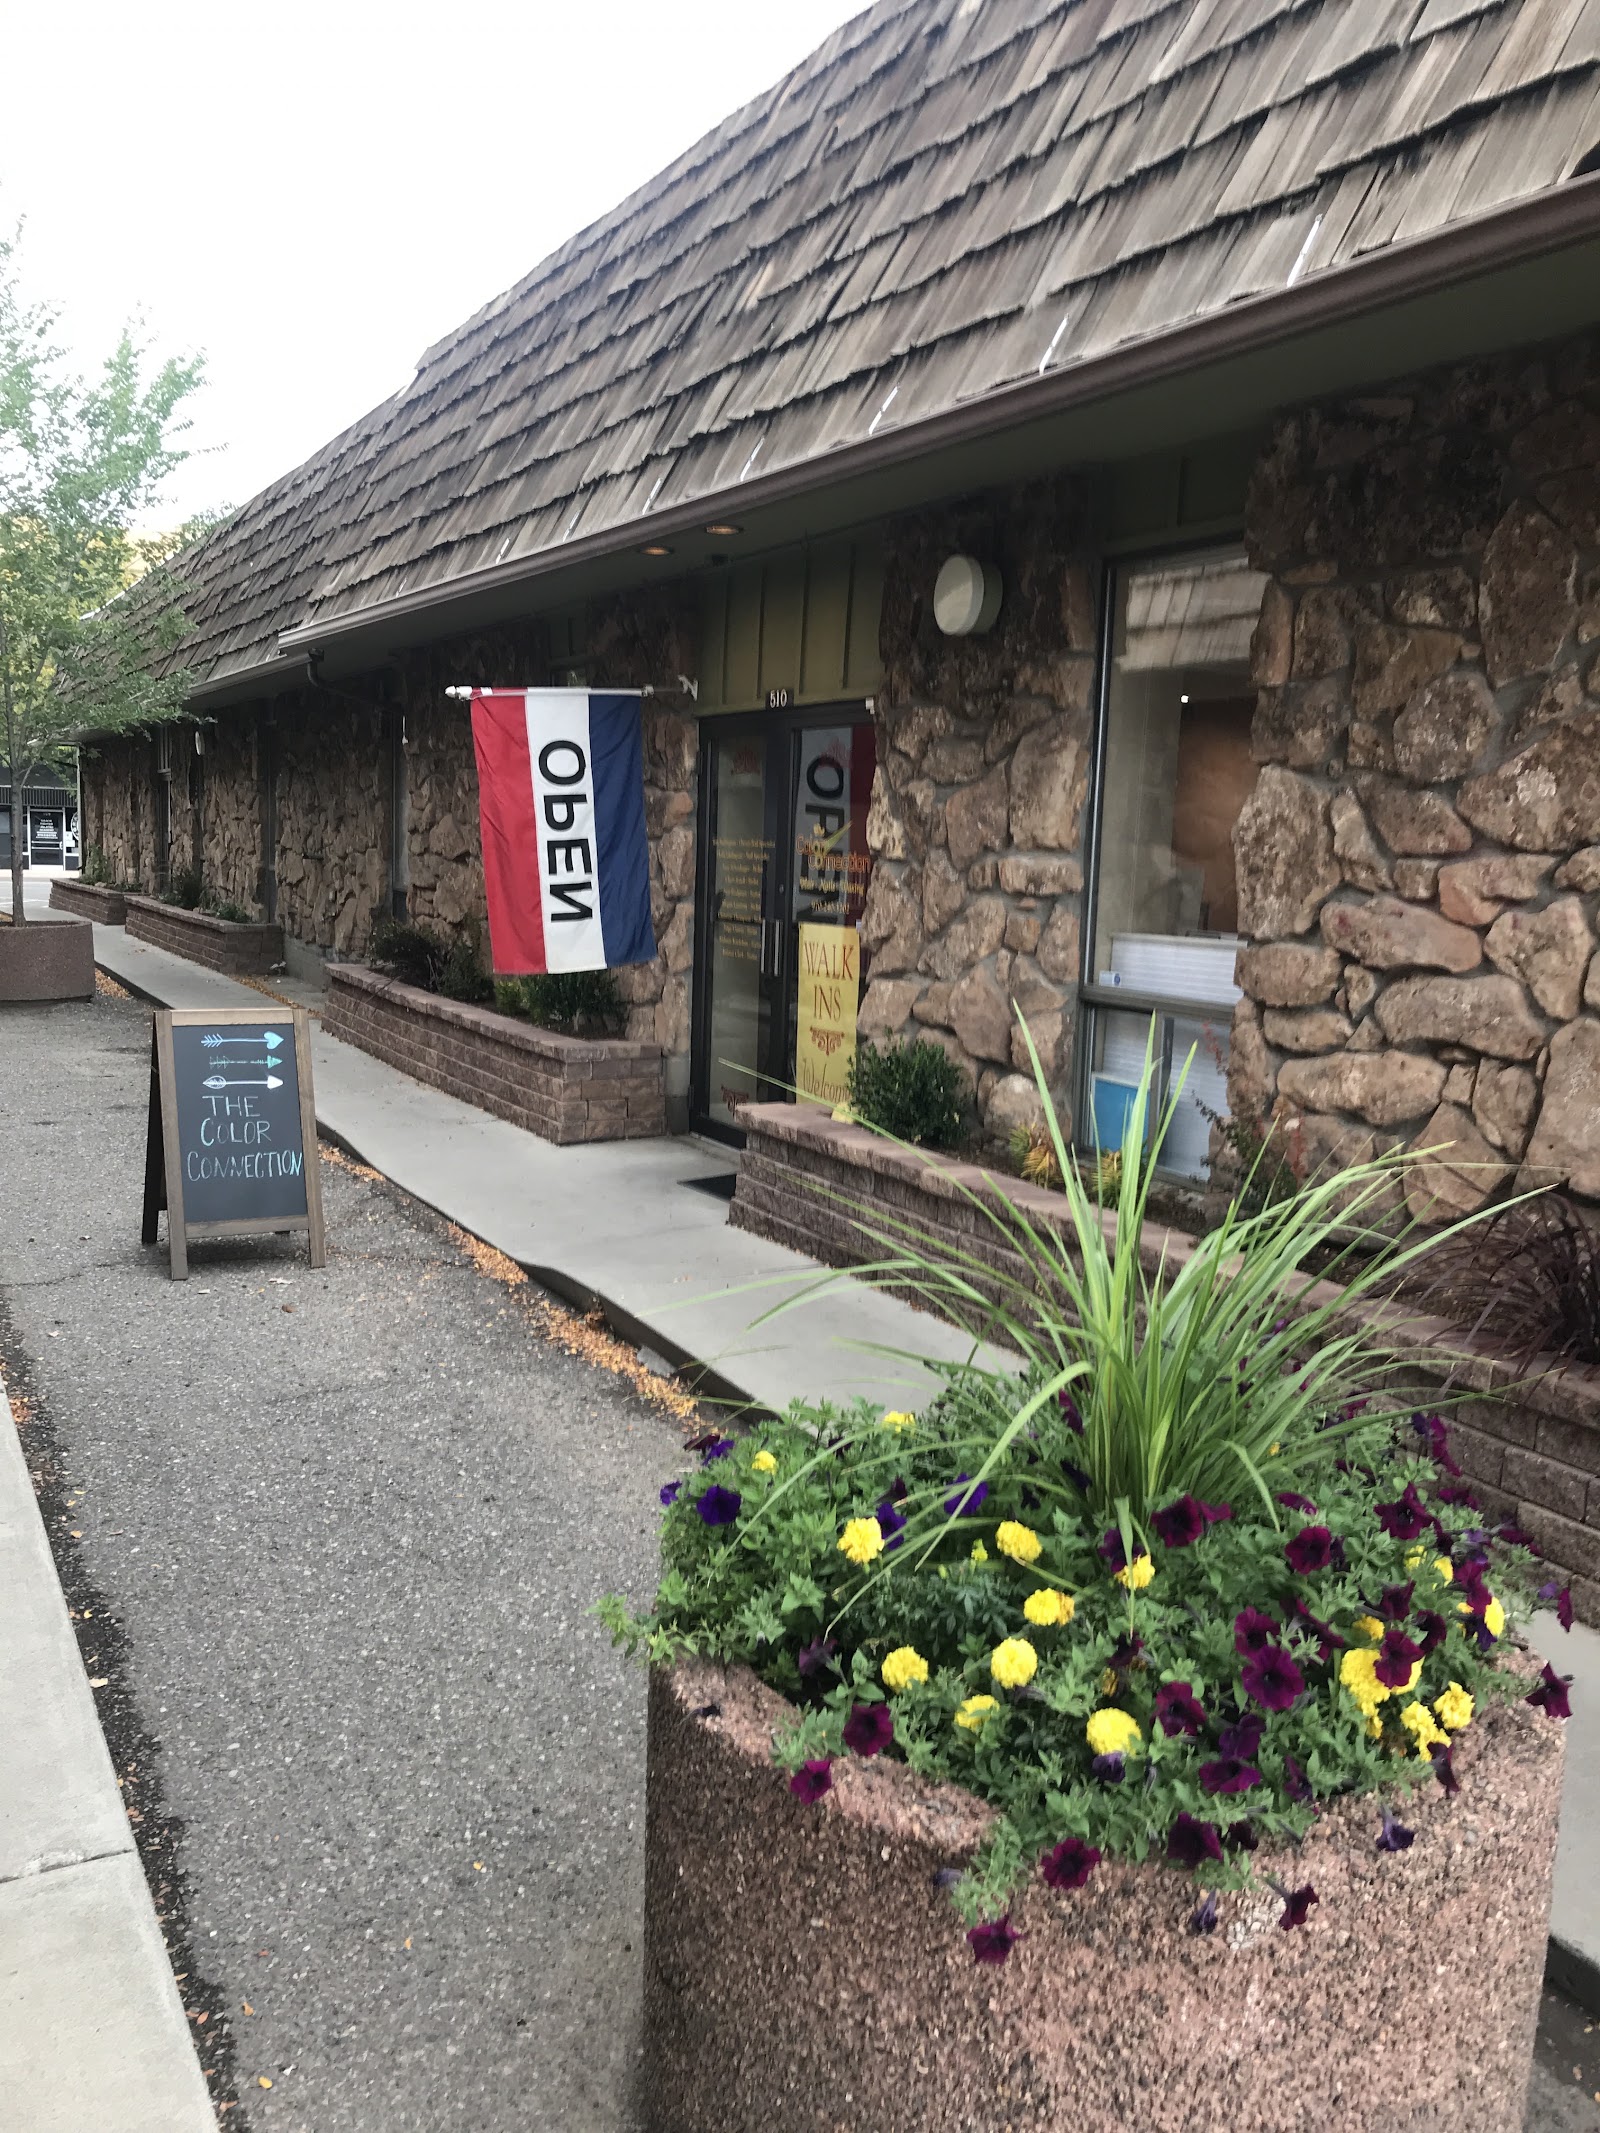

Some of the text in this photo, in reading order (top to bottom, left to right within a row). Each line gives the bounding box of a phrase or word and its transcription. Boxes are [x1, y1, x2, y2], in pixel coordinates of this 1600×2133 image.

[770, 689, 787, 708] 510
[804, 940, 854, 981] WALK
[813, 984, 842, 1022] INS
[202, 1095, 261, 1118] THE
[200, 1117, 272, 1146] COLOR
[187, 1150, 303, 1182] CONNECTION
